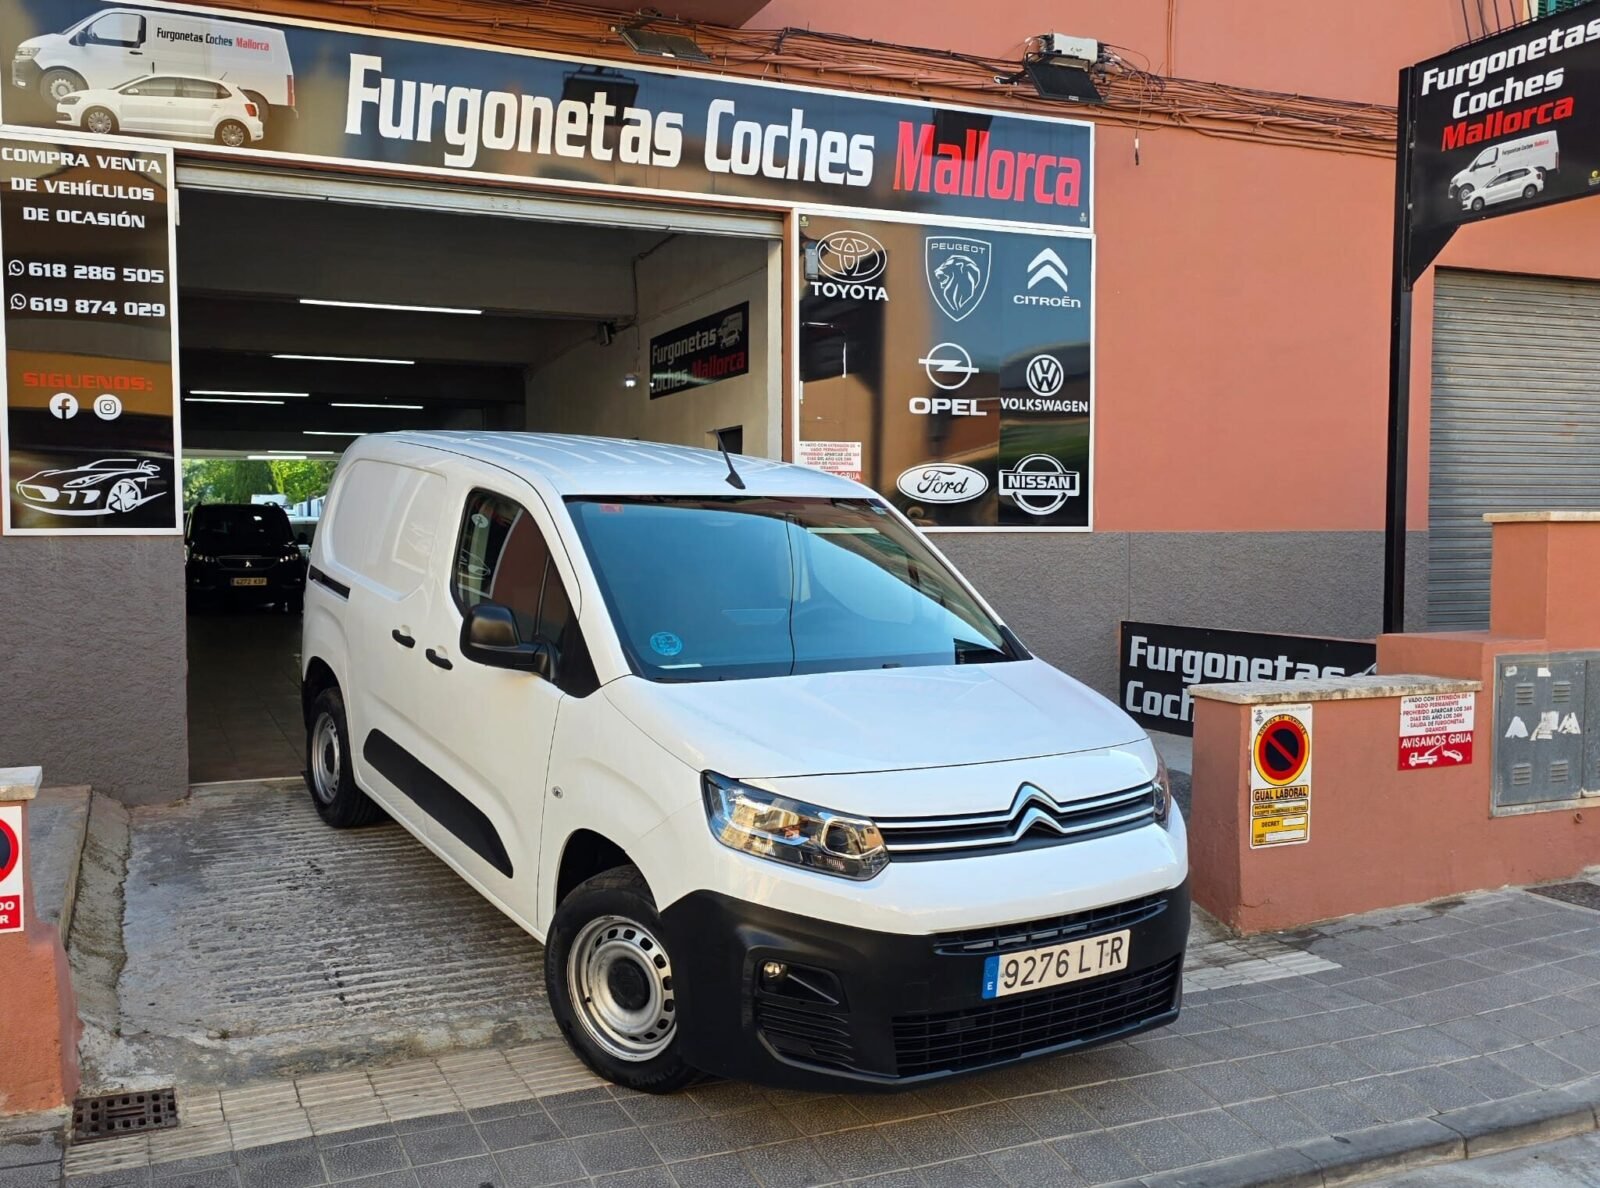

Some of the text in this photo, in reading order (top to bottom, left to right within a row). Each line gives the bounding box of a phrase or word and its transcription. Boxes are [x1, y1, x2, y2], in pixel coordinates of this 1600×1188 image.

[157, 27, 269, 51] Furgonetas Coches Mallorca
[1421, 18, 1600, 96] Furgonetas
[1452, 67, 1564, 119] Coches
[345, 52, 1082, 207] Furgonetas Coches Mallorca
[1441, 96, 1574, 152] Mallorca
[1, 147, 162, 174] COMPRA VENTA
[11, 177, 155, 201] DE VEHÍCULOS
[23, 207, 145, 228] DE OCASIÓN
[931, 243, 985, 254] PEUGEOT
[29, 262, 164, 283] 618 286 505
[810, 281, 889, 301] TOYOTA
[30, 297, 165, 317] 619 874 029
[652, 328, 717, 366] Furgonetas
[691, 352, 745, 378] Mallorca
[909, 397, 987, 416] OPEL
[1000, 397, 1088, 413] VOLKSWAGEN
[917, 469, 968, 494] Ford
[1008, 474, 1071, 489] NISSAN
[1125, 680, 1195, 722] Coch
[1401, 732, 1472, 749] AVISAMOS GRUA
[1255, 786, 1307, 801] GUAL LABORAL
[987, 981, 993, 991] E
[1003, 949, 1069, 988] 9276
